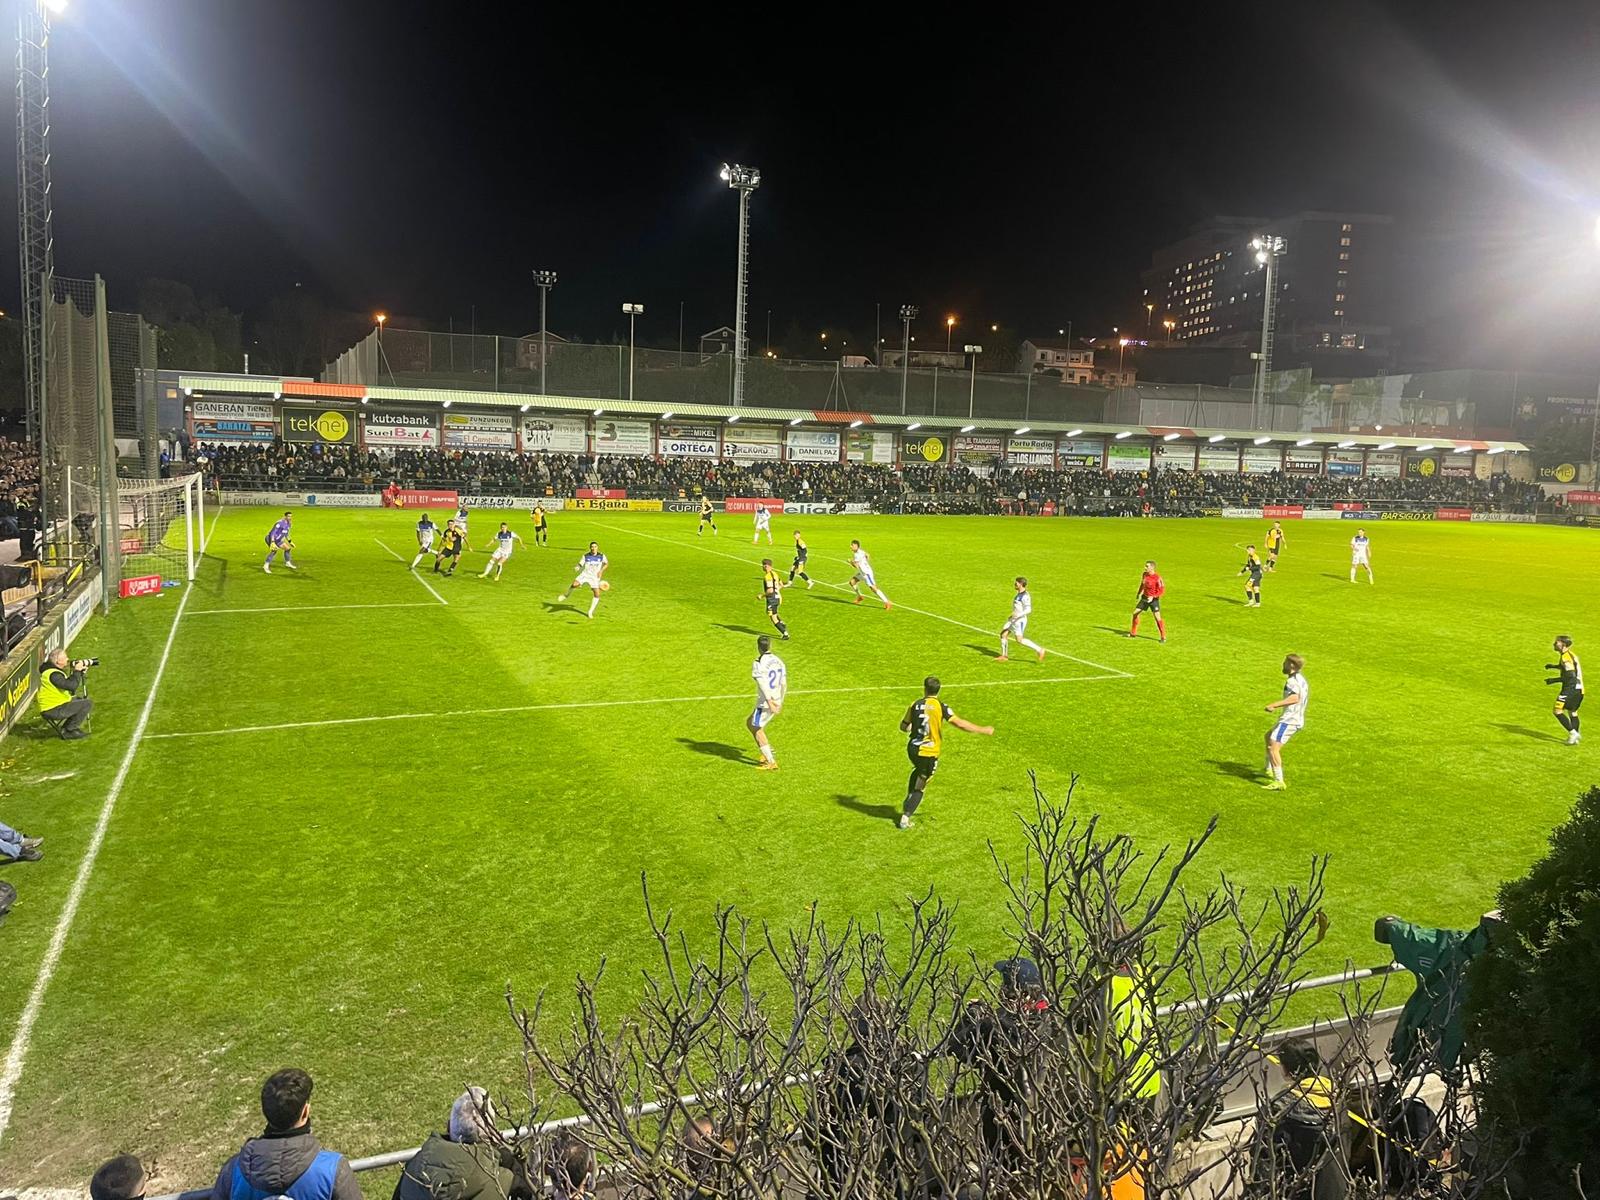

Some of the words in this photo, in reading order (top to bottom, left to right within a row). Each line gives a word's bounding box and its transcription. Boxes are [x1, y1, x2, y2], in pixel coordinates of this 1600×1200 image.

[289, 415, 346, 433] teknei
[372, 413, 429, 425] kutxabank
[670, 443, 714, 454] ORTEGA
[798, 447, 823, 455] DANIEL
[905, 440, 941, 454] teknei
[1408, 461, 1434, 473] teknei
[1540, 466, 1574, 478] teknei
[1380, 512, 1397, 520] BAR
[768, 668, 783, 690] 27
